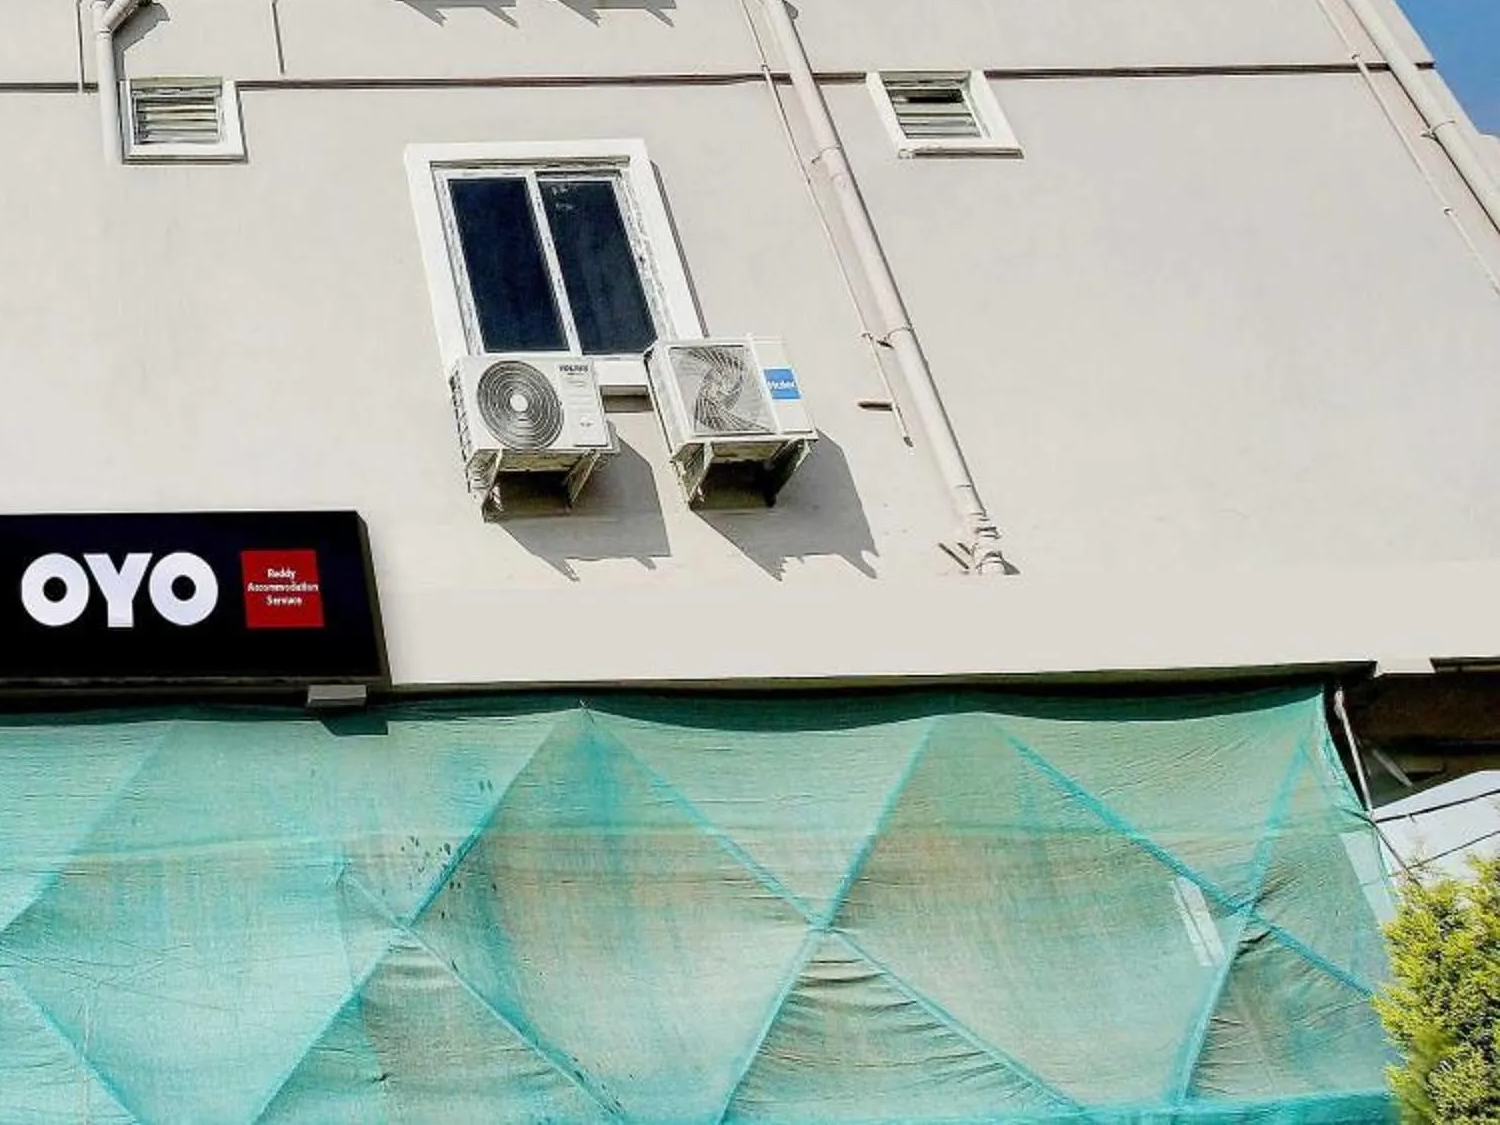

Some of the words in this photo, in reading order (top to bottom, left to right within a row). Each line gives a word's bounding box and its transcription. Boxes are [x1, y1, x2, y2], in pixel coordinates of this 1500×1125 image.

[267, 566, 297, 580] Reddy
[21, 552, 219, 628] OYO
[247, 581, 319, 592] Accommodation
